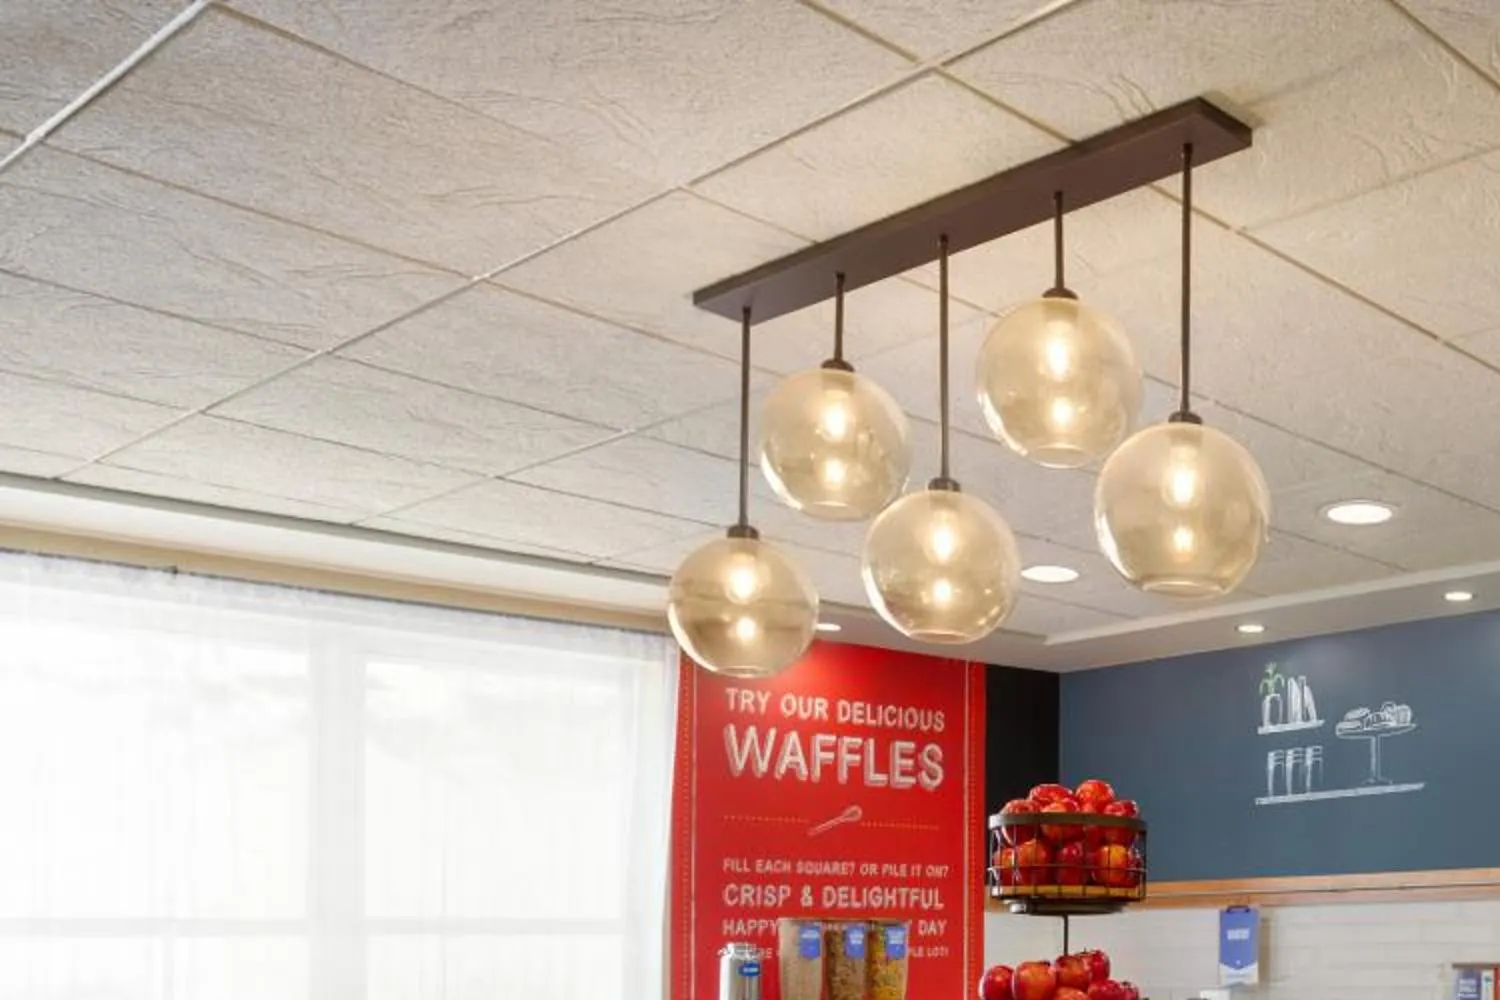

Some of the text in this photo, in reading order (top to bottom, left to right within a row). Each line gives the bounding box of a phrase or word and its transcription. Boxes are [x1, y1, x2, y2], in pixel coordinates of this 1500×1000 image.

[725, 687, 945, 733] TRY OUR DELICIOUS
[723, 723, 945, 791] WAFFLES
[722, 857, 750, 873] FILL
[755, 859, 791, 874] EACH
[796, 860, 855, 876] SQUARE?
[881, 863, 907, 877] PILE
[723, 882, 944, 910] CRISP & DELIGHTFUL
[722, 918, 778, 937] HAPPY
[918, 918, 948, 936] DAY
